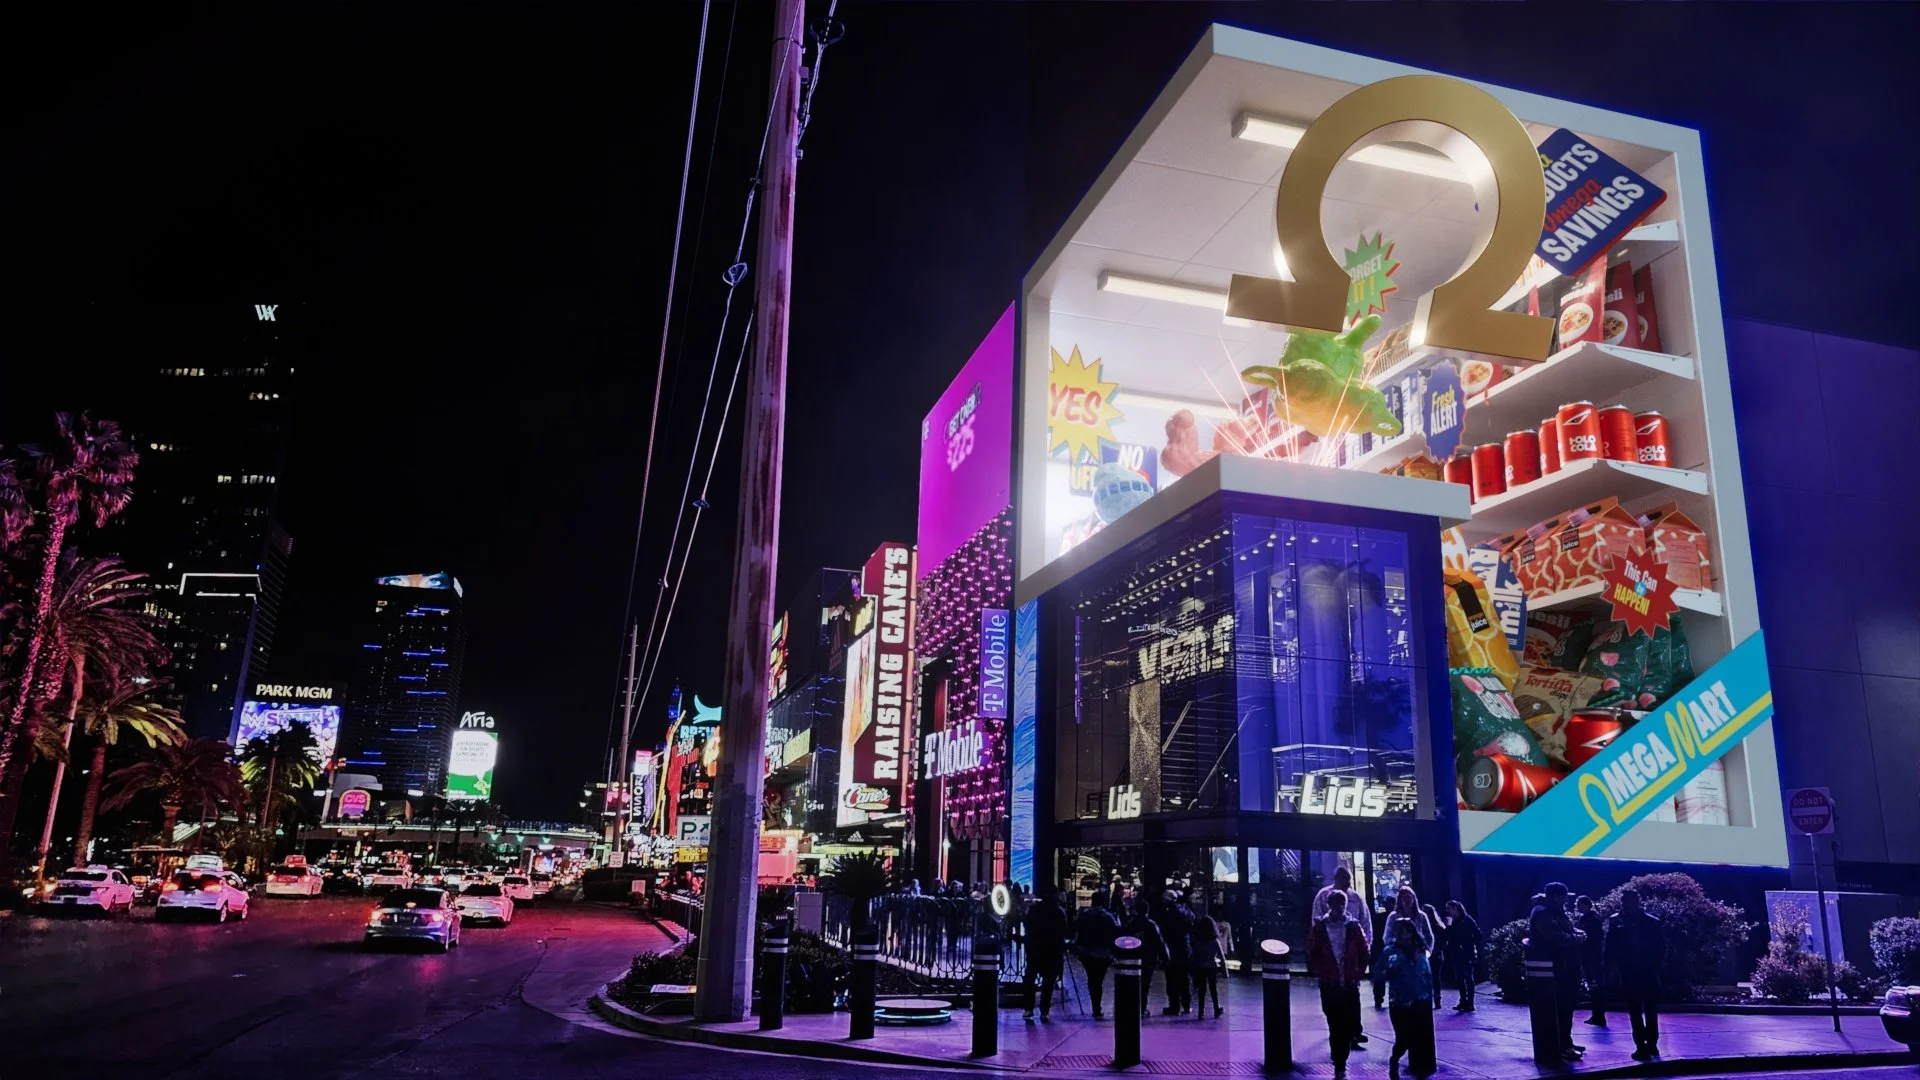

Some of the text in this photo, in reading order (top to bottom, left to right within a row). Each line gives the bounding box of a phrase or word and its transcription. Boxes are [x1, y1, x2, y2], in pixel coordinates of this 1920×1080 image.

[1541, 176, 1645, 262] SAVINGS
[1050, 381, 1102, 427] YES
[1431, 384, 1455, 409] Fresh
[1430, 400, 1458, 436] ALERT
[1117, 443, 1145, 472] NO
[1570, 442, 1597, 453] COLA
[1640, 454, 1667, 463] COLA
[1562, 539, 1579, 551] juice
[1624, 560, 1658, 592] This Can
[1493, 579, 1523, 636] milk
[1470, 618, 1488, 631] juice
[873, 547, 909, 780] RAISING CANE'S
[256, 684, 333, 699] PARK MGM
[1525, 674, 1574, 693] Tortilla
[459, 711, 495, 729] Aria
[1664, 680, 1737, 756] MART
[345, 793, 366, 804] CVS
[845, 786, 890, 808] Cane's
[1108, 784, 1141, 820] Lids
[1301, 774, 1385, 817] Lids
[1793, 797, 1823, 806] DO NOT
[1800, 816, 1824, 825] ENTER
